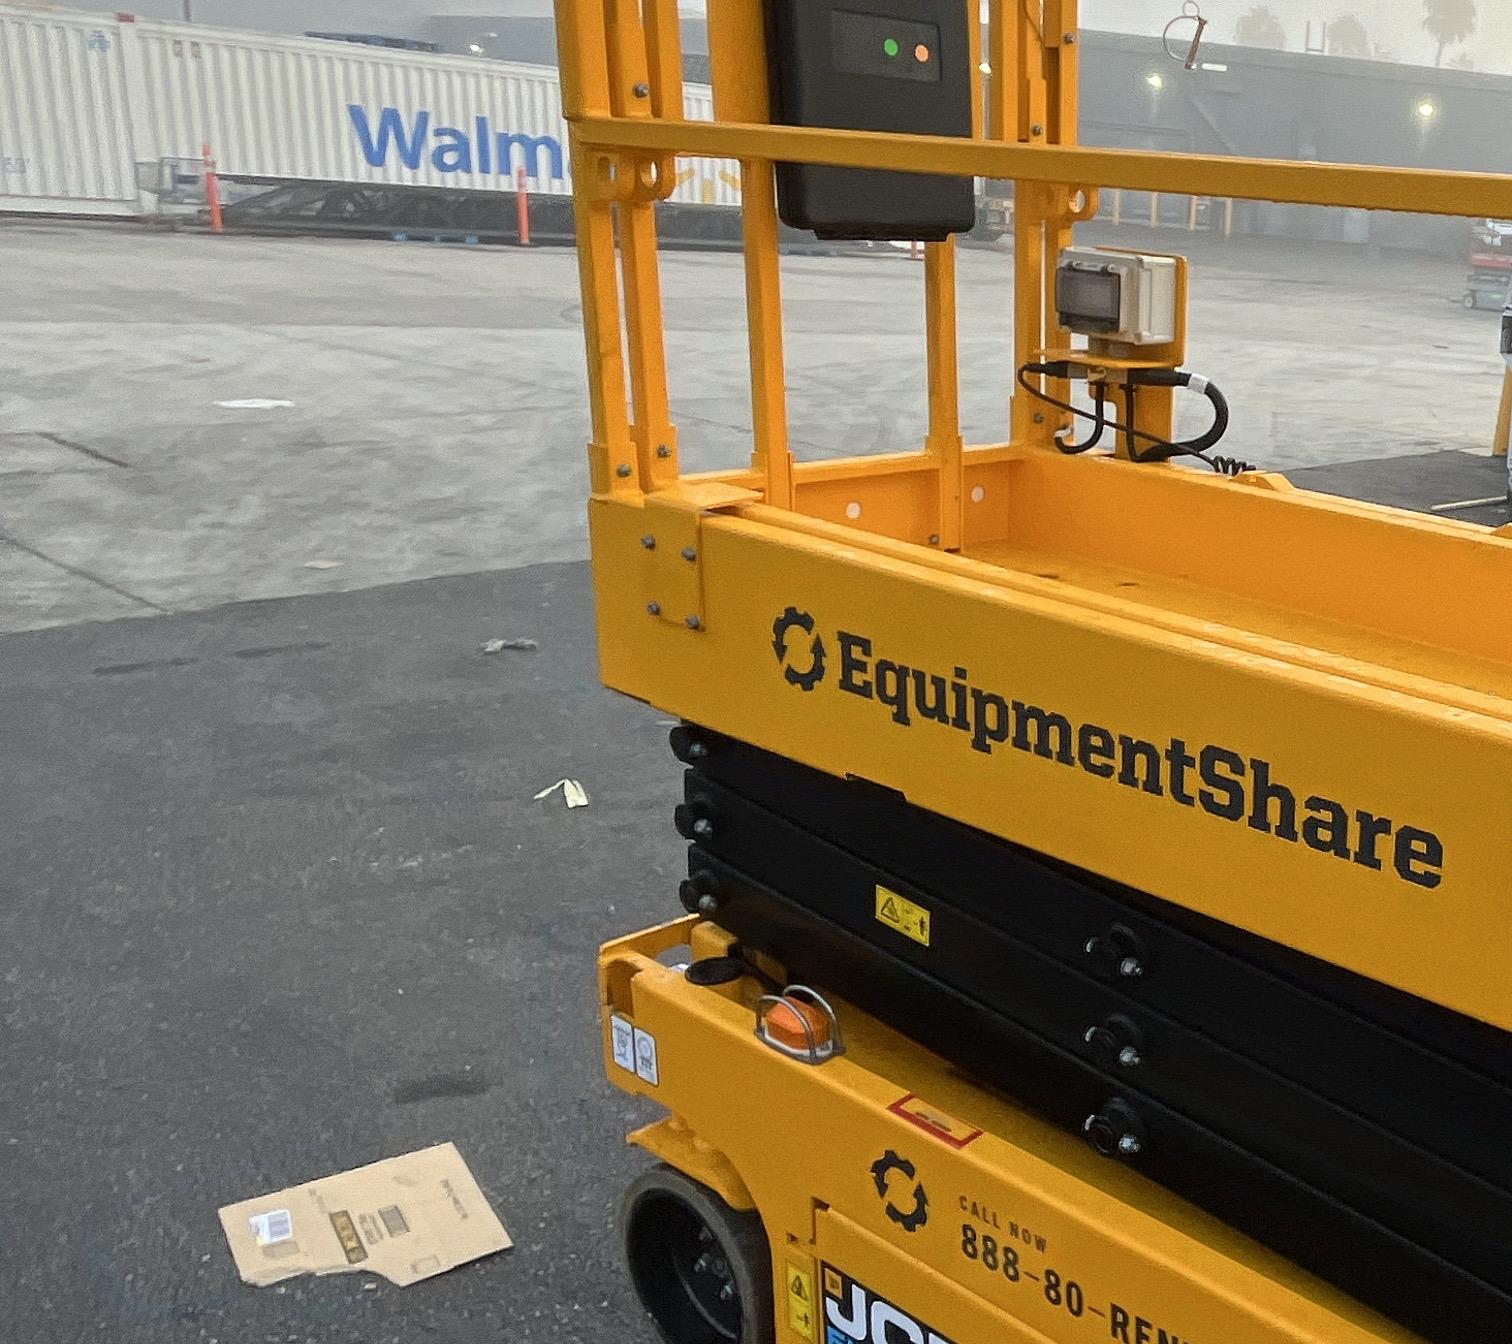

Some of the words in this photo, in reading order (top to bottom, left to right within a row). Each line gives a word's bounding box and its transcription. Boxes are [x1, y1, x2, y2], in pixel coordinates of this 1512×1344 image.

[348, 103, 564, 180] Walm
[836, 631, 1445, 889] EquipmentShare
[959, 1196, 1000, 1230] CALL
[1009, 1220, 1048, 1254] NOW
